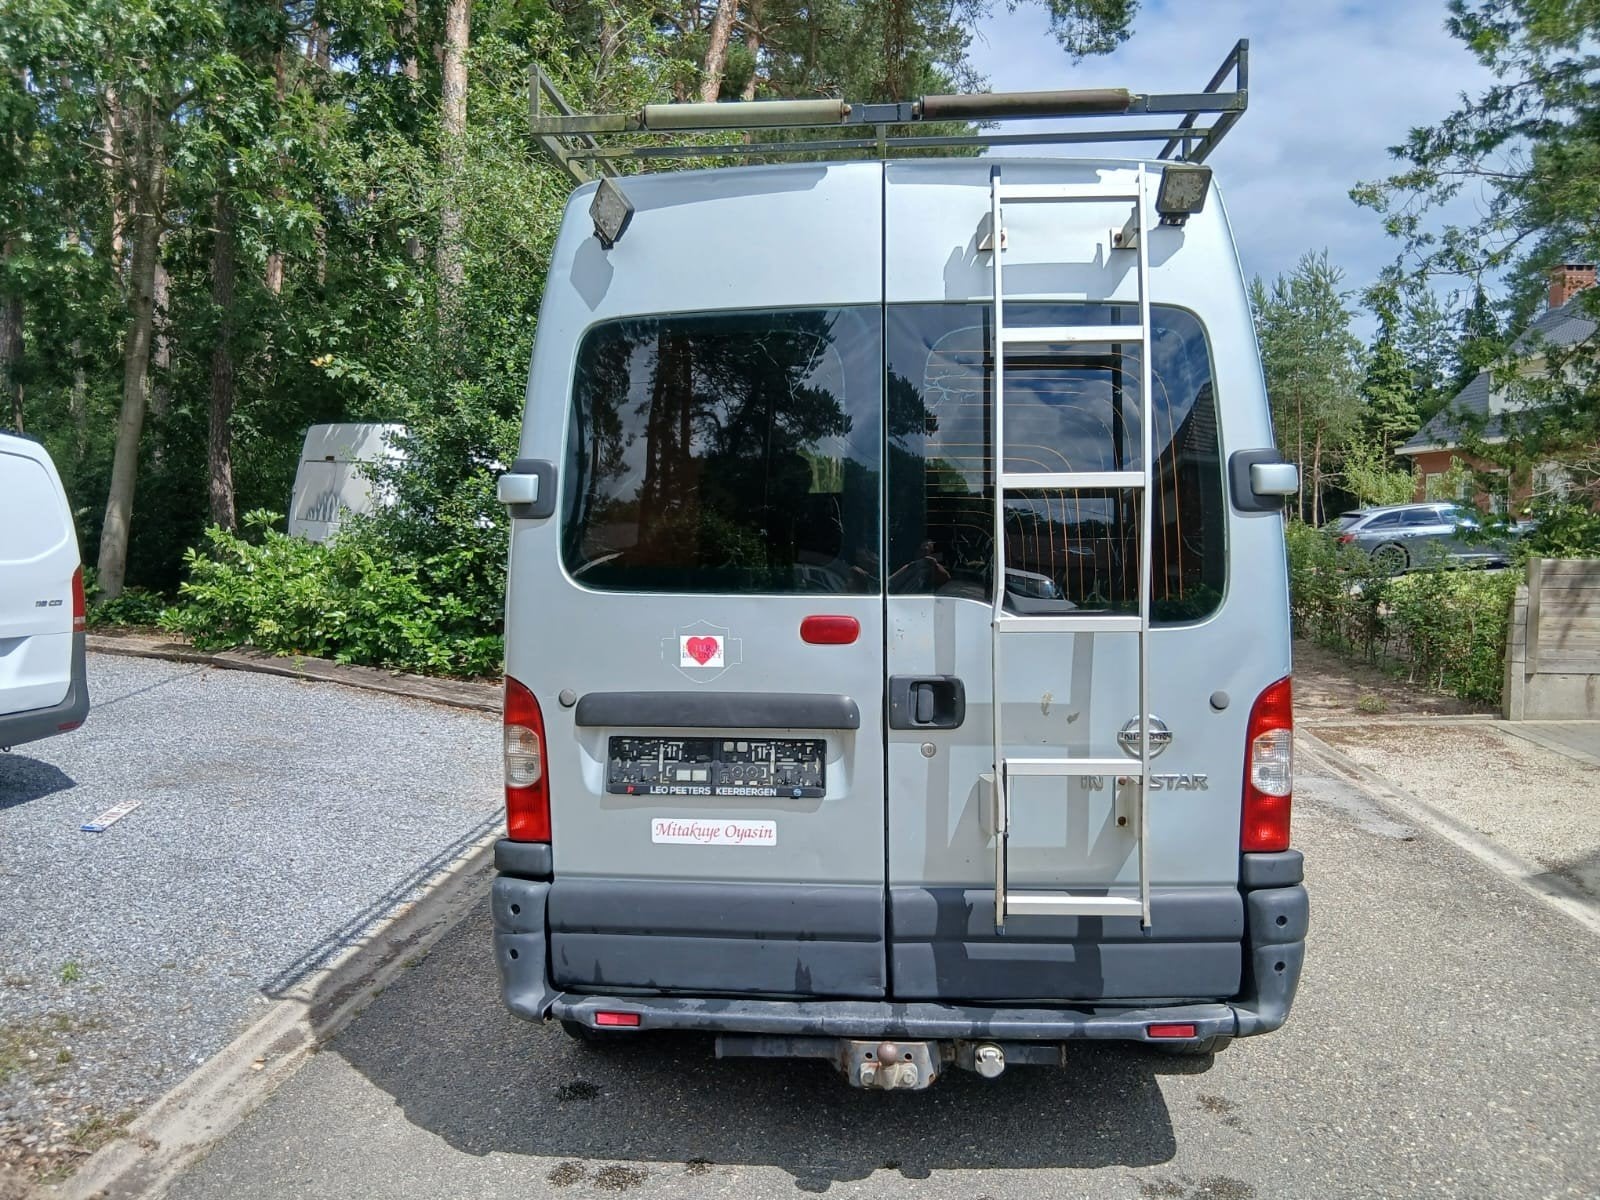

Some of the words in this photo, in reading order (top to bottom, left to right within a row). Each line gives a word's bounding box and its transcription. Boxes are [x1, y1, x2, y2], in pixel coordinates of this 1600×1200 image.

[1080, 774, 1209, 791] INSTAR
[649, 786, 668, 795] LEO
[669, 786, 711, 796] PEETERS
[715, 787, 777, 797] KEERBERGEN
[655, 821, 720, 843] Mitakuye
[724, 824, 774, 844] Oyasin
